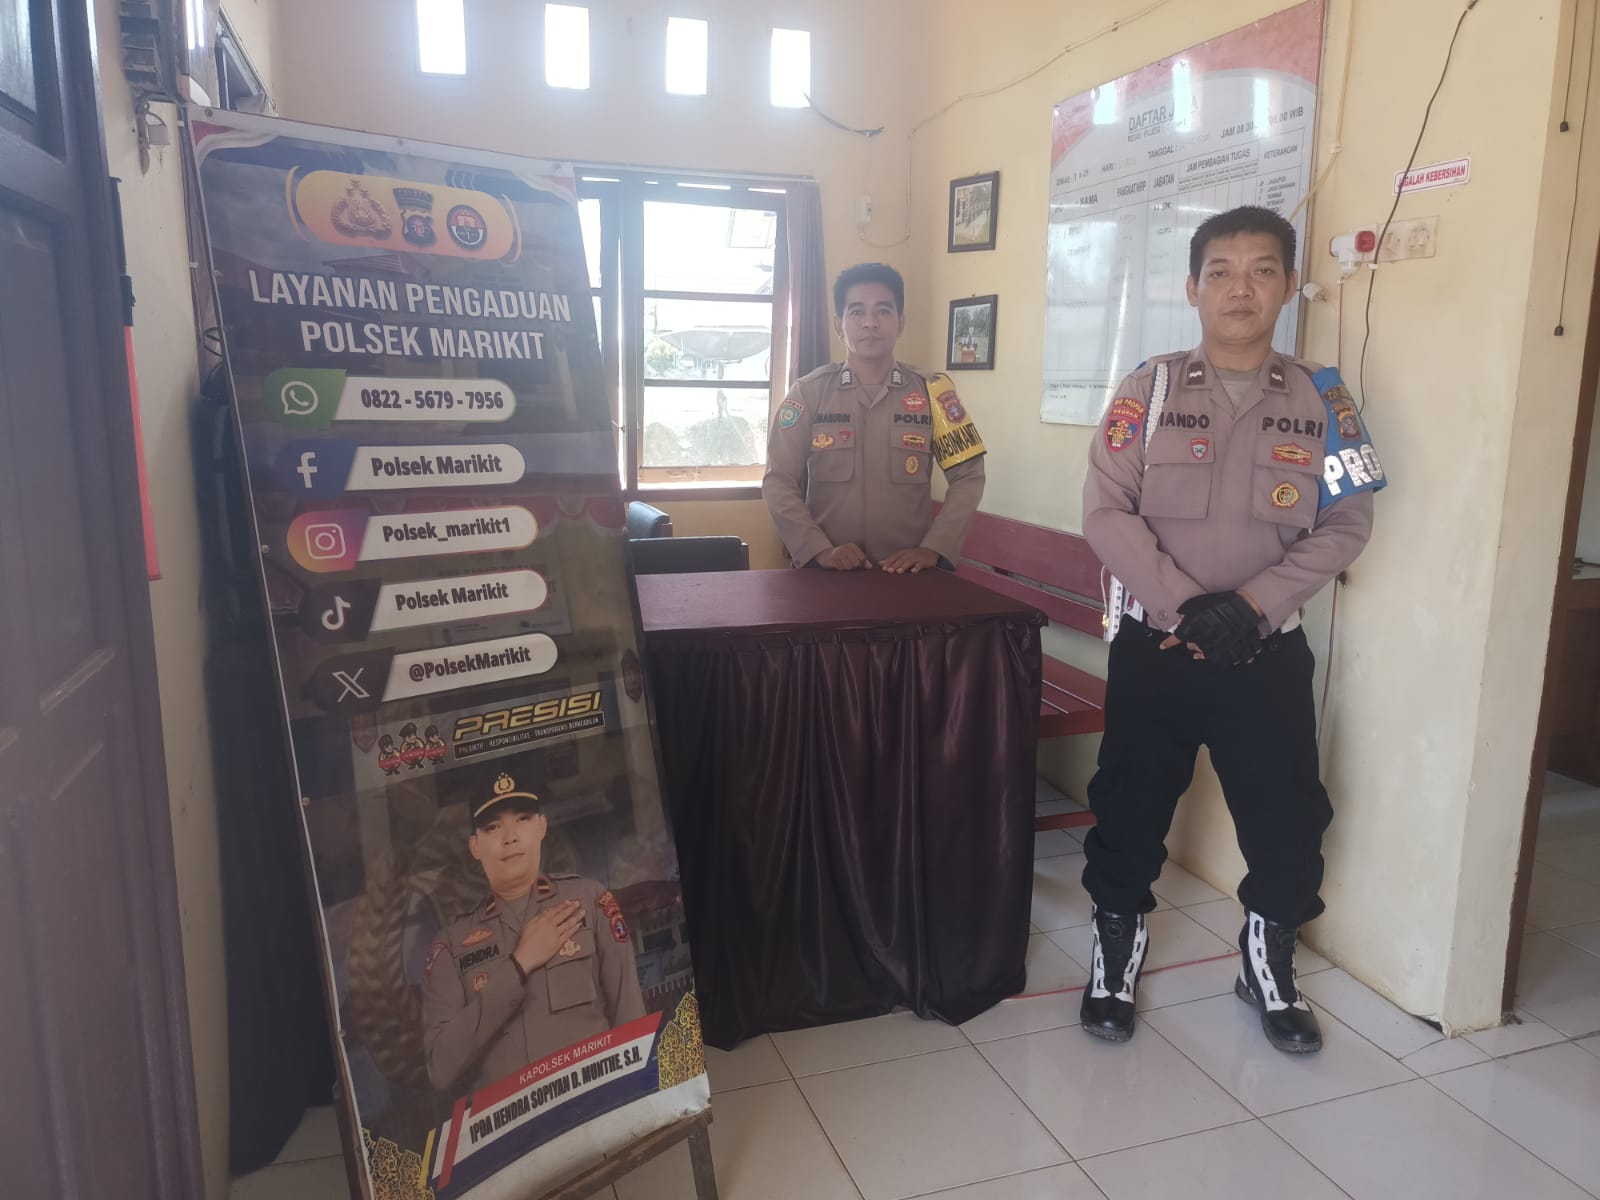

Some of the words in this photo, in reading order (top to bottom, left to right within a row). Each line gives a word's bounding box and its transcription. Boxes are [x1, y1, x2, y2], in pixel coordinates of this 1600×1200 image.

[1128, 105, 1167, 132] DAFTAR
[1220, 126, 1236, 139] JAM
[1289, 106, 1304, 119] WIB
[1231, 148, 1250, 161] TUGAS
[1263, 144, 1298, 160] KETERANGAN
[1397, 174, 1425, 189] GALAH
[1425, 165, 1466, 182] KEBERSIHAN
[249, 269, 398, 312] LAYANAN
[406, 283, 572, 322] PENGADUAN
[300, 320, 423, 357] POLSEK
[430, 328, 545, 361] MARIKIT
[360, 389, 402, 409] 0822
[415, 390, 454, 410] 5679
[465, 391, 504, 410] 7956
[894, 413, 933, 426] POLRI
[1261, 416, 1324, 439] POLRI
[371, 456, 433, 477] Polsek
[437, 454, 503, 475] Marikit
[382, 517, 511, 543] Polsek_marikit1
[395, 589, 449, 611] Polsek
[451, 582, 509, 605] Marikit
[408, 646, 531, 683] @PolsekMarikit
[453, 690, 602, 742] PRESISI
[459, 943, 501, 972] HENDRA
[519, 1053, 571, 1085] KAPOLSEK
[572, 1034, 613, 1058] MARIKIT
[470, 1117, 493, 1145] IPDA
[493, 1099, 531, 1130] HENDRA
[531, 1080, 571, 1109] SOPIYAN
[571, 1074, 582, 1091] D.
[582, 1055, 624, 1087] MUNTHE,
[624, 1045, 643, 1068] S.H.
